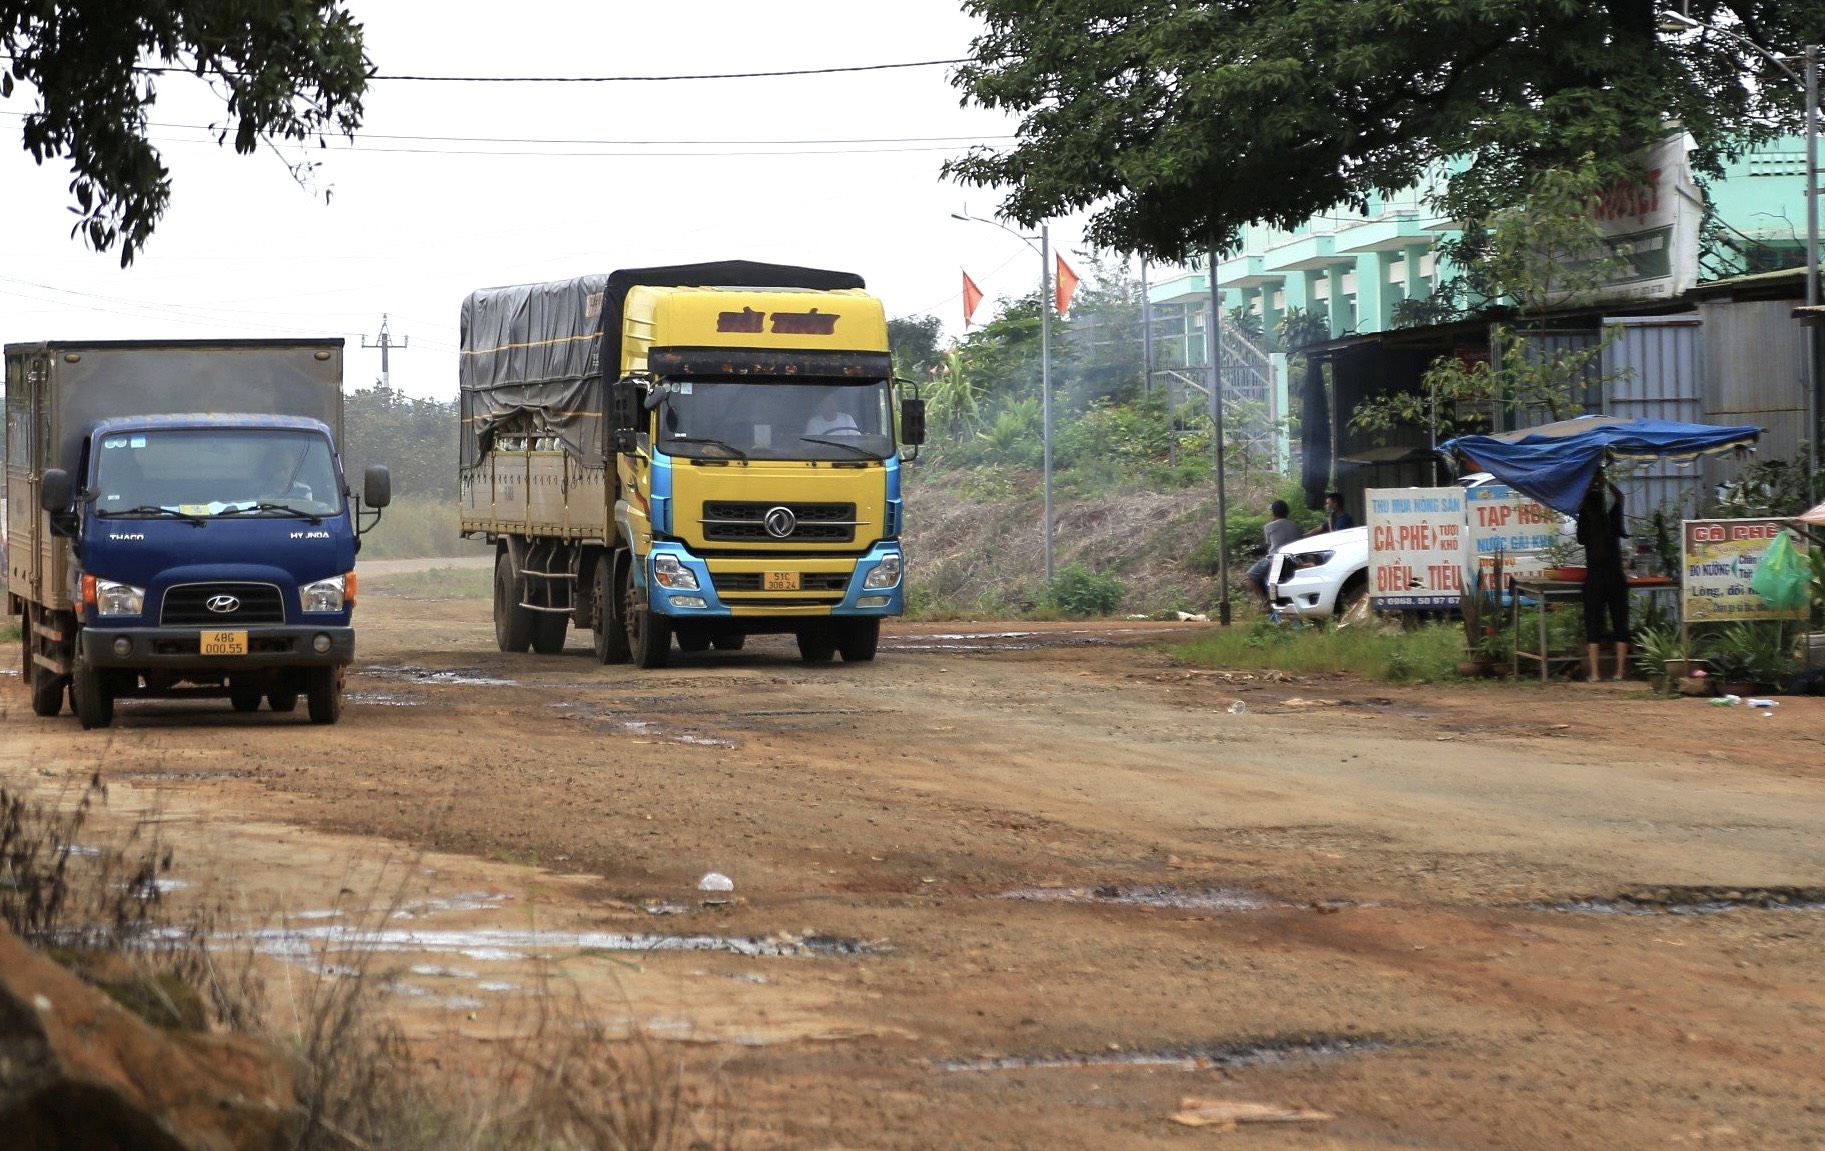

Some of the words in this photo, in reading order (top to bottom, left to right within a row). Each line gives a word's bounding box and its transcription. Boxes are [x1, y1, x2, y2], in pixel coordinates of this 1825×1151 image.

[1371, 499, 1389, 513] THU
[1391, 499, 1411, 513] MUA
[1477, 504, 1511, 531] TẠP
[1374, 520, 1396, 552] CÀ
[1400, 519, 1431, 551] PHÊ
[774, 572, 790, 581] 51C
[1427, 559, 1462, 591] TIÊU
[205, 643, 243, 654] 000.55
